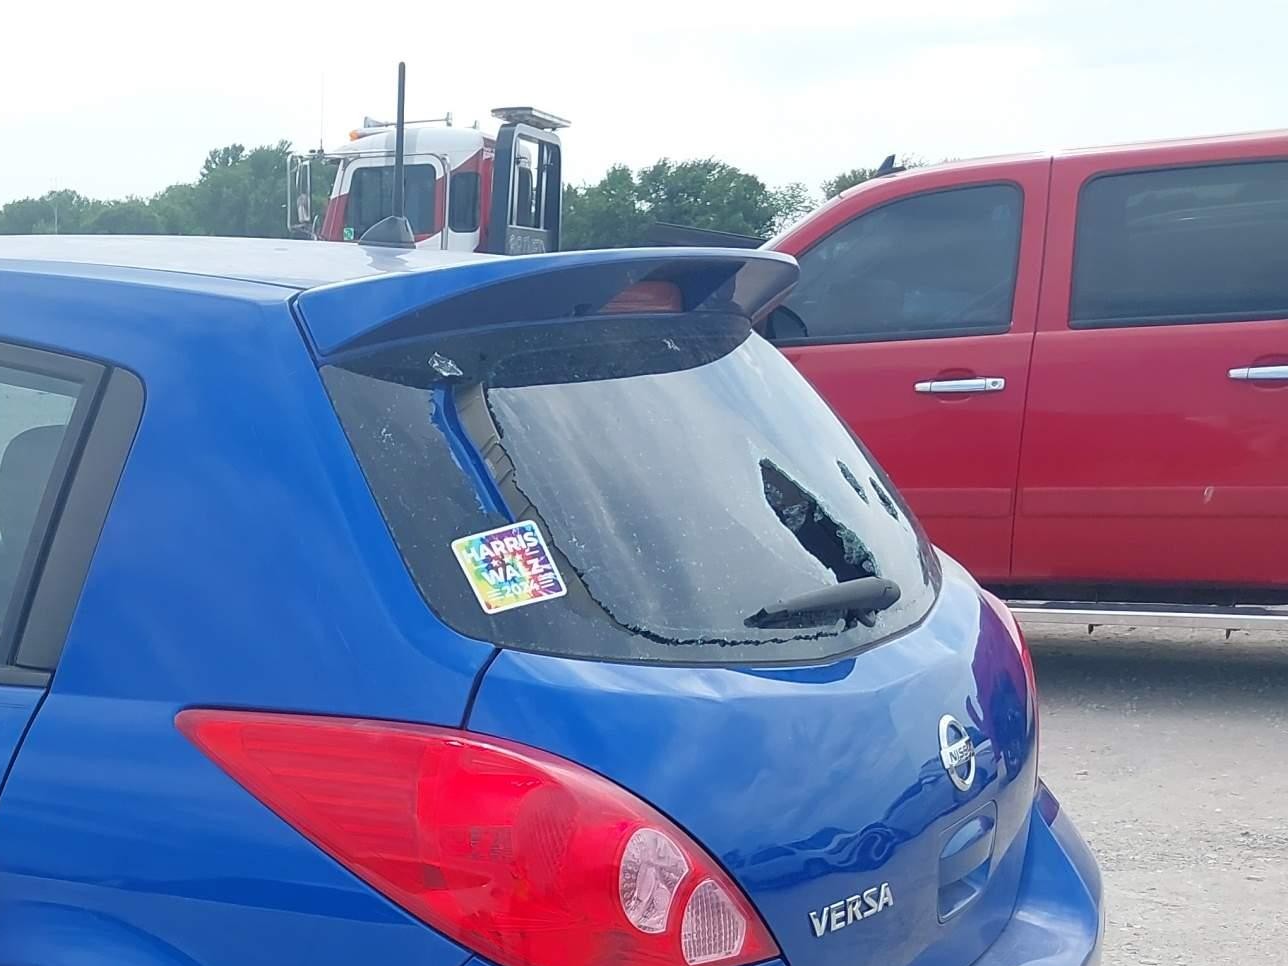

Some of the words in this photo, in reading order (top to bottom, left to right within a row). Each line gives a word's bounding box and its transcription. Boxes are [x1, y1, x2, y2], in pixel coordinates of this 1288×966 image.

[462, 532, 539, 562] HARRIS
[481, 557, 544, 586] WALZ
[500, 579, 540, 598] 2024
[809, 883, 894, 937] VERSA
